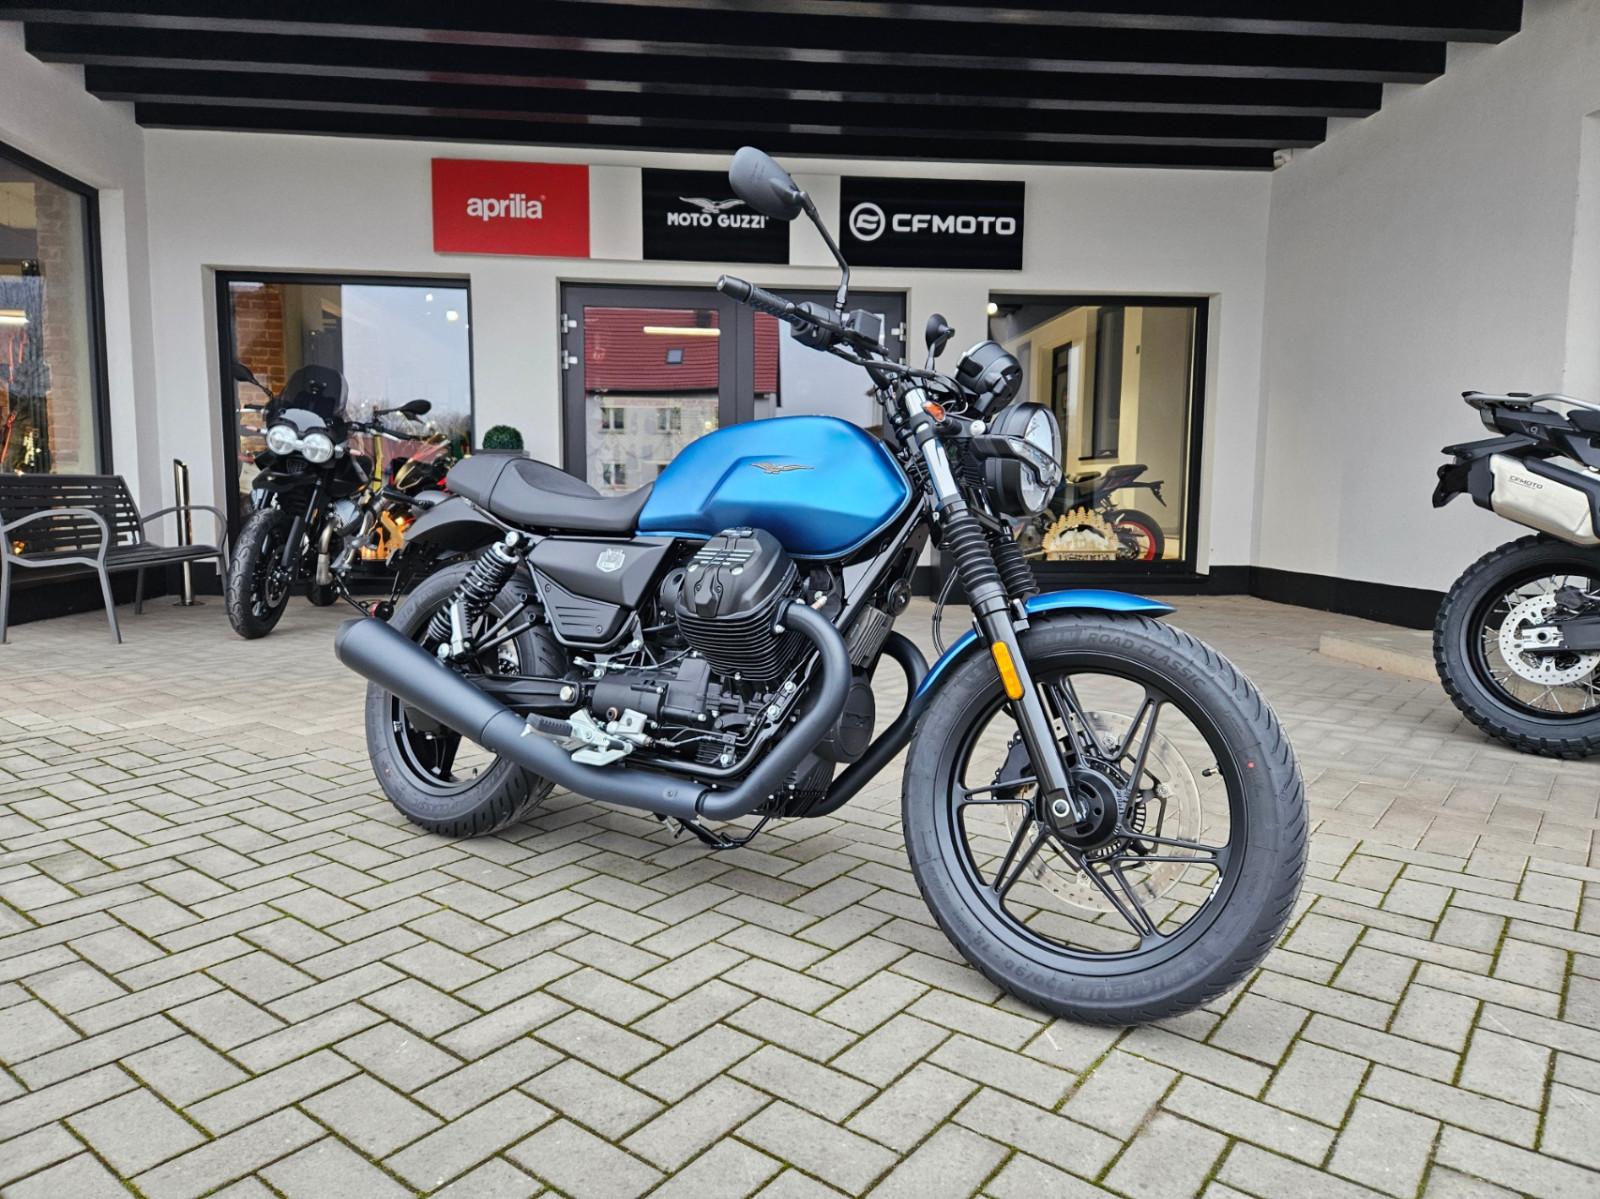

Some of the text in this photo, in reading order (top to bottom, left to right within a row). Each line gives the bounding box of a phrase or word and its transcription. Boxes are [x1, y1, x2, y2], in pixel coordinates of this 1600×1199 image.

[466, 193, 543, 222] aprilia
[667, 212, 765, 229] MOTO GUZZI
[892, 213, 1016, 236] CFMOTO
[1510, 475, 1544, 490] CFMOTO
[1087, 632, 1135, 650] ROAD
[1141, 643, 1207, 690] CLASSIC
